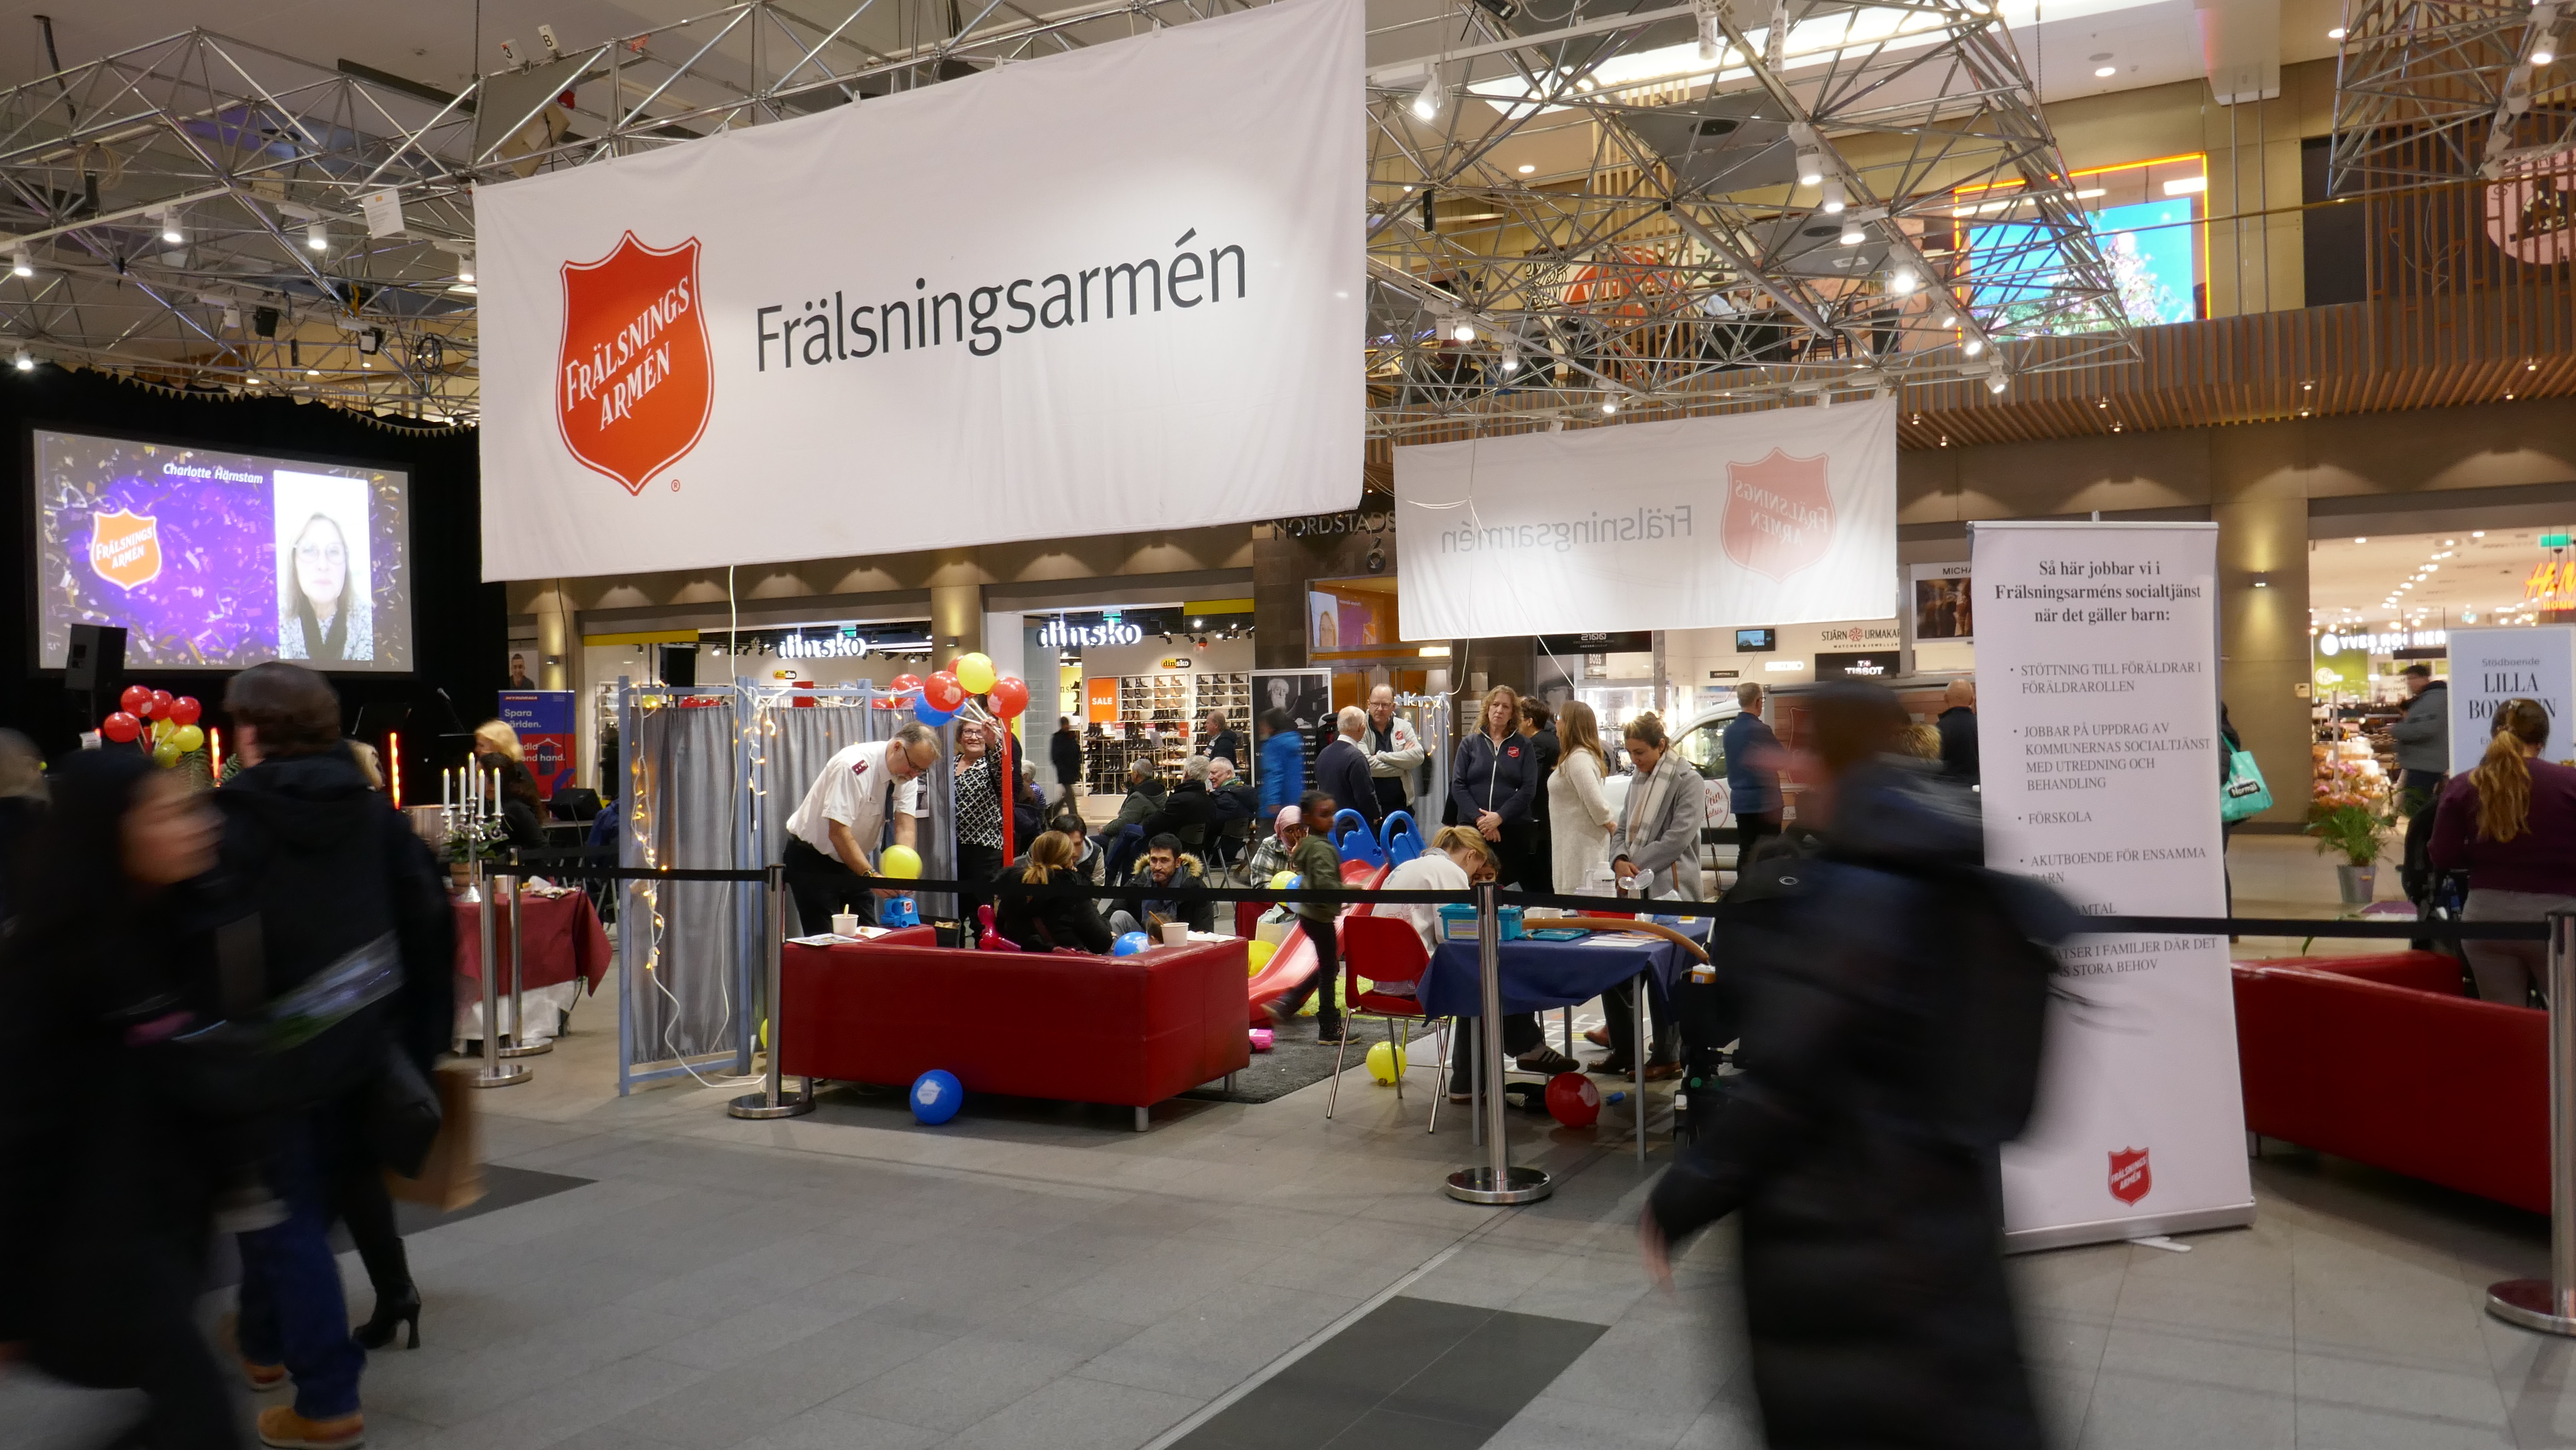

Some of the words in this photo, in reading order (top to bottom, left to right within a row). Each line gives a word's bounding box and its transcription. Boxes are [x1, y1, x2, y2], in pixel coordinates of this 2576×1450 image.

[543, 35, 553, 47] B
[503, 48, 513, 58] 3
[757, 226, 1246, 372] Frälsningsarmén
[566, 275, 690, 412] FRÄLSNINGS
[600, 340, 670, 432] ARMÉN
[163, 463, 211, 479] Charlotte
[214, 467, 264, 484] Härnstam
[96, 526, 153, 561] FRÄLSNINGS
[112, 544, 145, 569] ARMÉN
[1367, 536, 1386, 574] 6
[2039, 560, 2056, 575] Så
[2061, 561, 2085, 575] här
[2088, 561, 2134, 579] jobbar
[2139, 561, 2152, 575] vi
[2155, 561, 2161, 575] i
[1995, 583, 2122, 602] Frälsningsarméns
[2126, 583, 2201, 601] socialtjänst
[2542, 600, 2575, 611] HOME
[2035, 609, 2058, 622] när
[2062, 609, 2084, 622] det
[2088, 608, 2127, 625] gäller
[2131, 608, 2170, 621] barn:
[1036, 619, 1142, 648] dinsko
[1822, 629, 1848, 641] STJÄRN
[2340, 635, 2376, 649] YVES
[776, 633, 867, 659] dinsko
[1589, 653, 1601, 665] BOSS
[1844, 666, 1884, 675] TISSOT
[2021, 662, 2089, 676] STÖTTNING
[2092, 663, 2118, 675] TILL
[2121, 661, 2194, 674] FÖRÄLDRAR
[2197, 662, 2201, 673] I
[2022, 680, 2135, 693] FÖRÄLDRAROLLEN
[2484, 672, 2538, 693] LILLA
[504, 709, 532, 718] Spara
[2024, 725, 2070, 738] JOBBAR
[2074, 722, 2089, 736] PÅ
[2093, 723, 2148, 735] UPPDRAG
[2152, 722, 2170, 734] AV
[2025, 742, 2121, 756] KOMMUNERNAS
[2124, 737, 2210, 752] SOCIALTJÄNST
[540, 753, 565, 761] hand.
[2026, 762, 2053, 773] MED
[2056, 758, 2126, 772] UTREDNING
[2130, 757, 2155, 769] OCH
[2027, 777, 2106, 791] BEHANDLING
[2231, 782, 2257, 797] Normal
[2029, 811, 2092, 824] FÖRSKOLA
[2031, 851, 2113, 867] AKUTBOENDE
[2117, 848, 2139, 862] FÖR
[2143, 847, 2206, 861] ENSAMMA
[2095, 946, 2099, 956] I
[2103, 942, 2160, 956] FAMILJER
[2165, 938, 2189, 951] DÄR
[2194, 937, 2216, 949] DET
[2073, 962, 2113, 977] STORA
[2117, 959, 2158, 972] BEHOV
